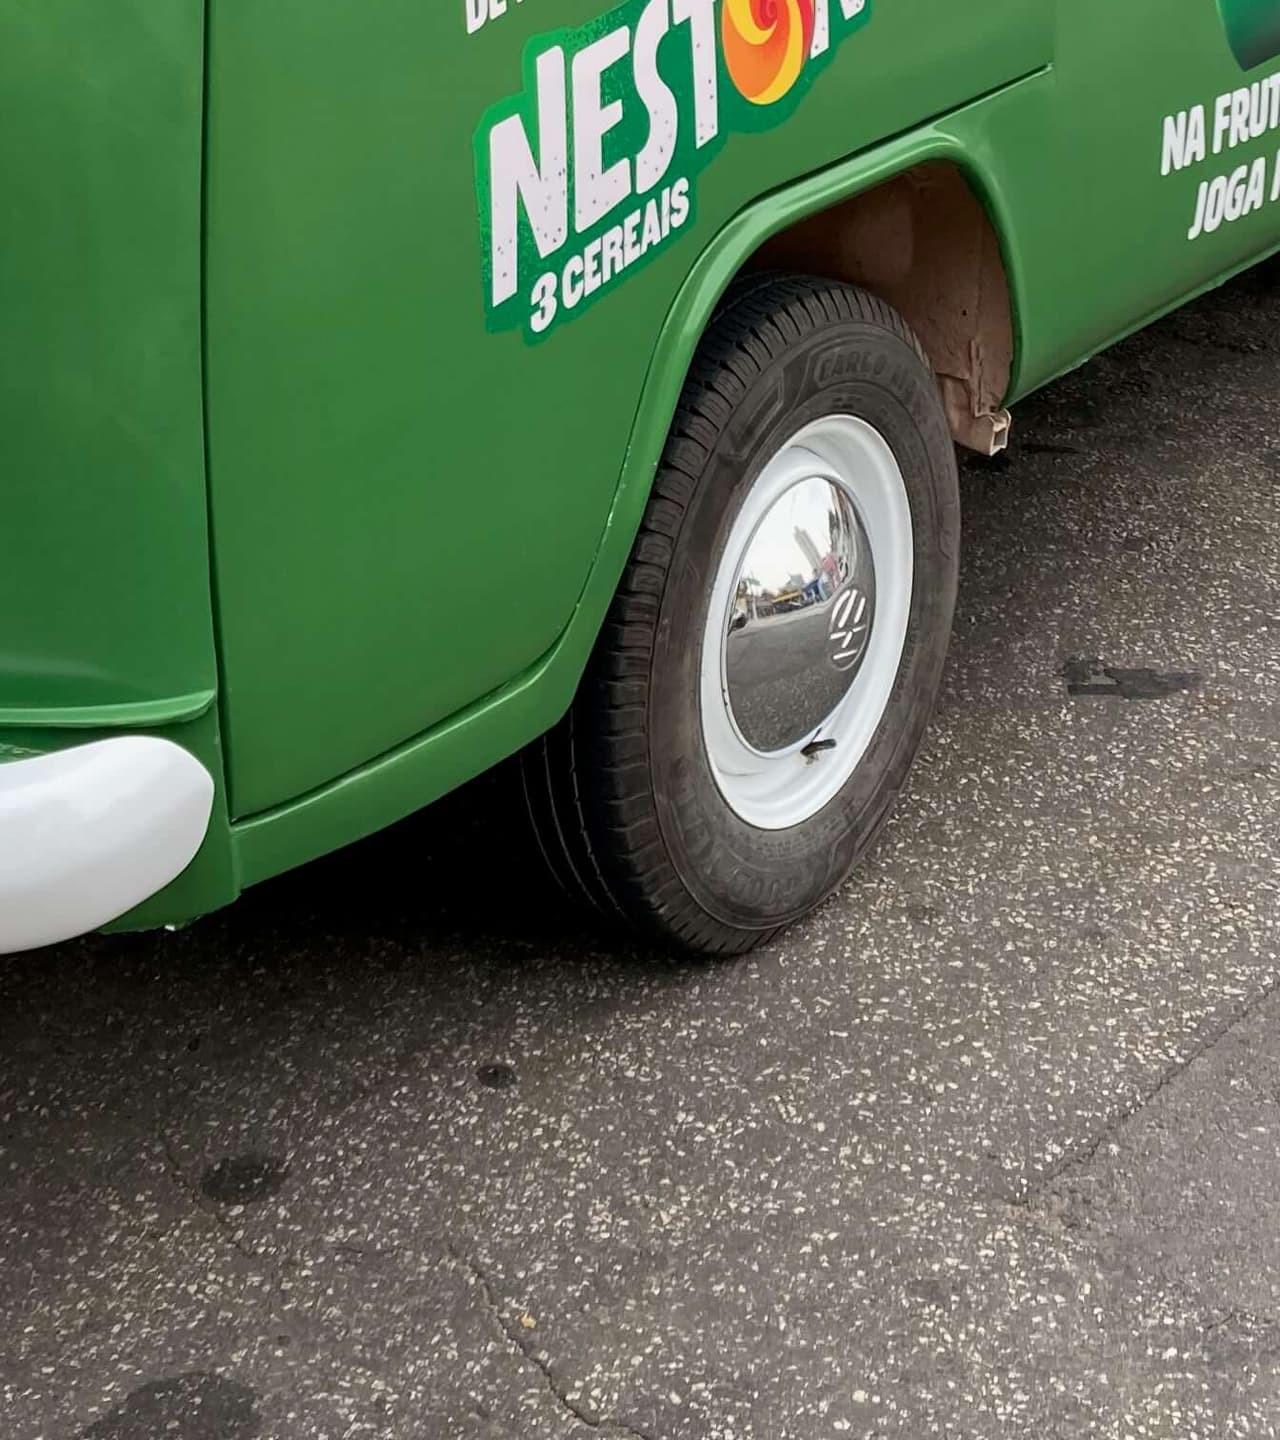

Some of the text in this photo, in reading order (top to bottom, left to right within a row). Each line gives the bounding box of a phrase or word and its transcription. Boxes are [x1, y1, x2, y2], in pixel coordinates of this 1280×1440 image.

[1160, 104, 1205, 175] NA
[1187, 157, 1265, 240] JOGA
[530, 177, 690, 333] 3 CEREAIS
